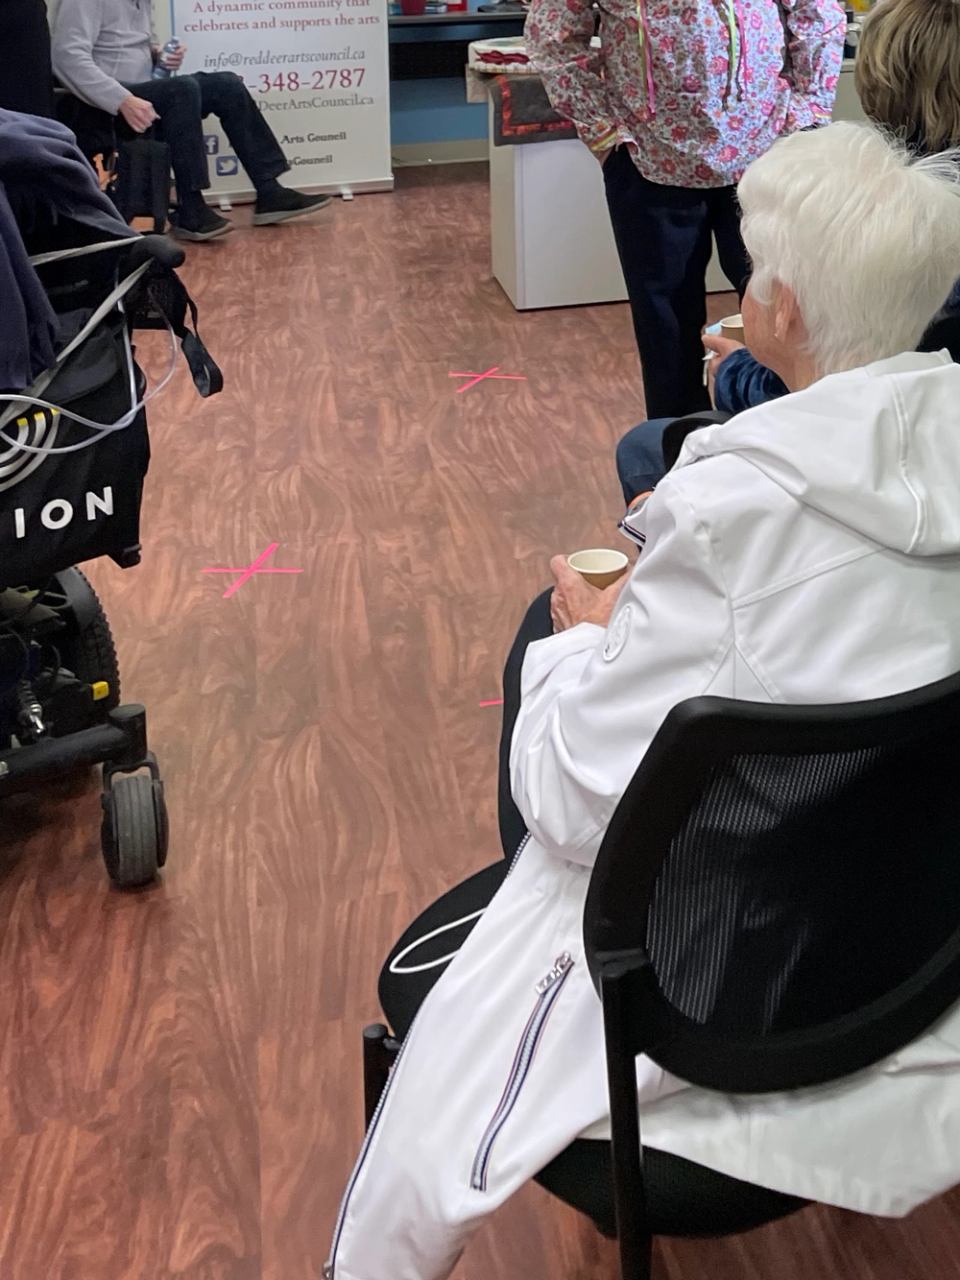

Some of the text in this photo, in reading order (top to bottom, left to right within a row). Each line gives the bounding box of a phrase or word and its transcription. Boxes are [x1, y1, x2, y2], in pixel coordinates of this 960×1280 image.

[193, 1, 204, 13] A
[207, 0, 265, 16] dynamic
[184, 13, 381, 33] celebrates and supports the arts
[204, 46, 366, 69] info@reddeerartscouncil.ca
[258, 92, 375, 112] DeerArtsCouncil.ca
[280, 135, 305, 144] Arts
[14, 486, 114, 539] ION
